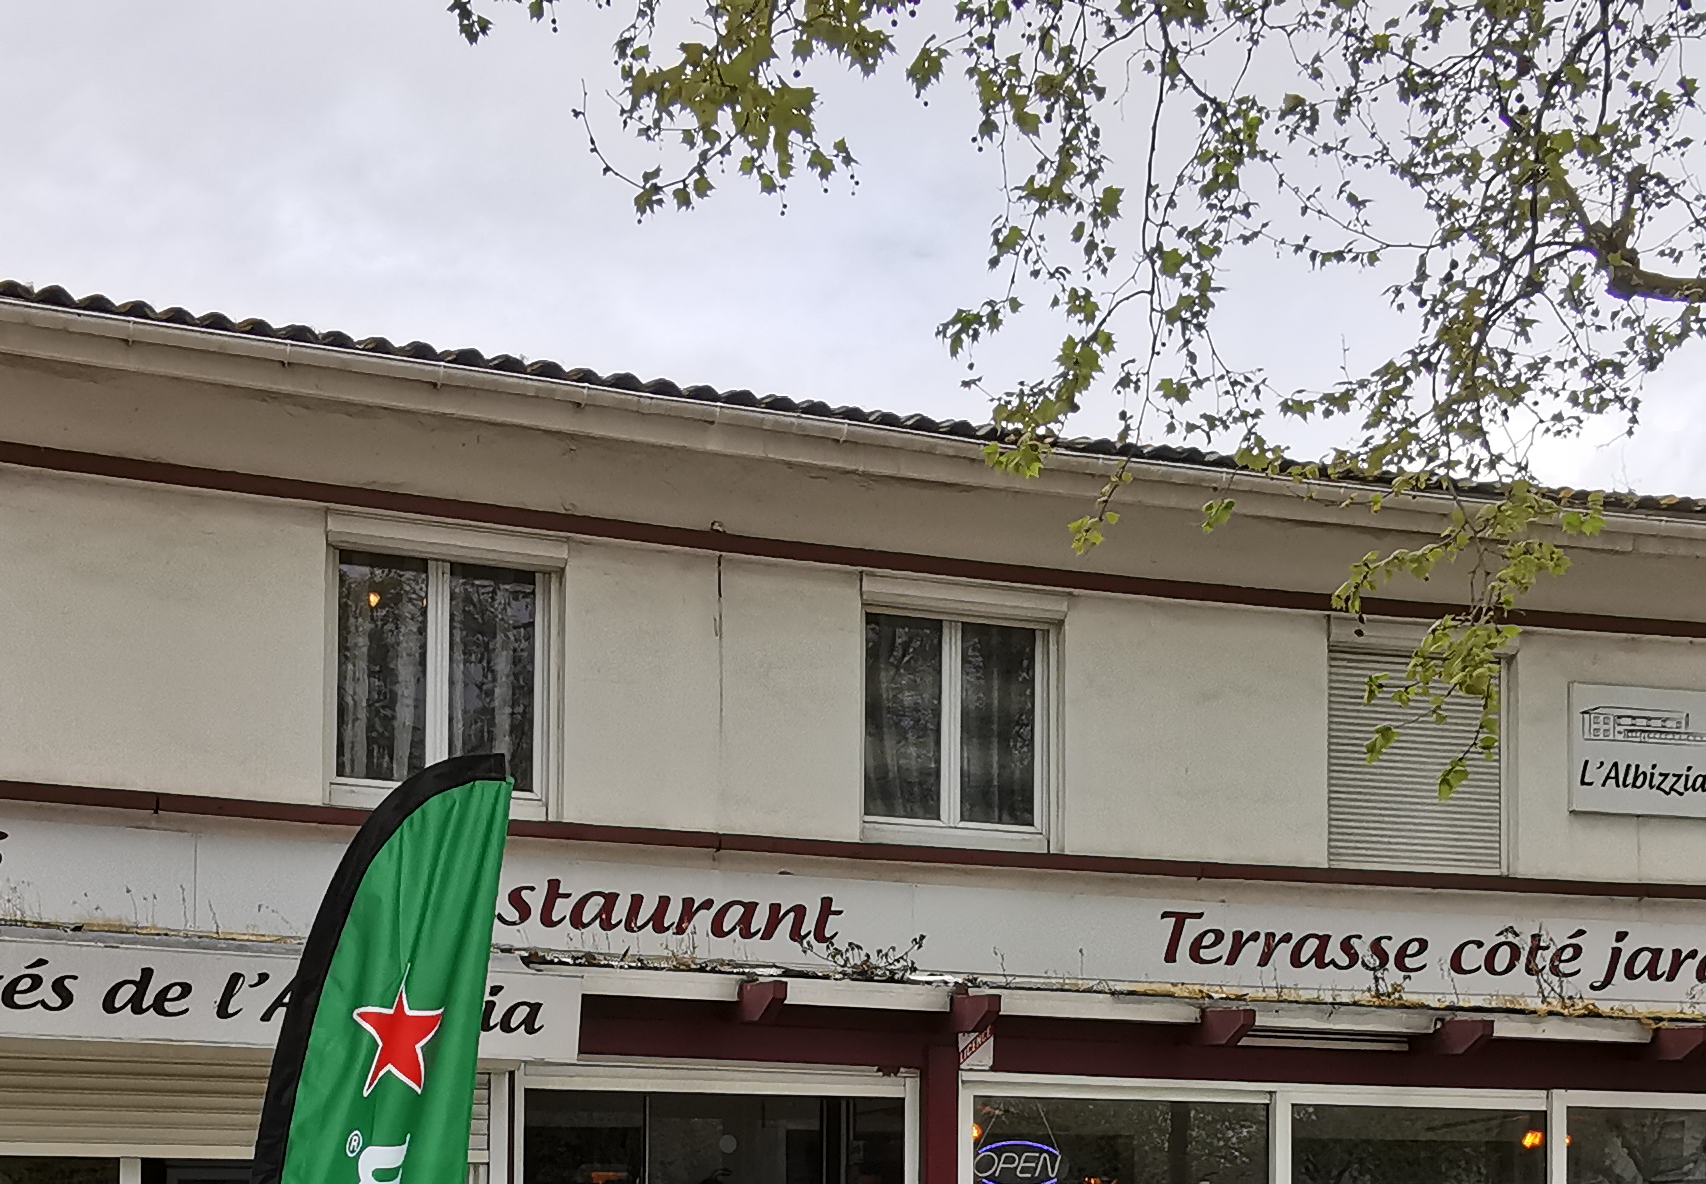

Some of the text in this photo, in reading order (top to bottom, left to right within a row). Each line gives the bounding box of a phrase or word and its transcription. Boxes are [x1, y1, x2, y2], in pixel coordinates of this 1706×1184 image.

[496, 878, 845, 944] staurant
[1160, 910, 1429, 973] Terrasse
[1449, 925, 1588, 977] côté
[101, 966, 194, 1018] de
[974, 1151, 1062, 1178] OPEN
